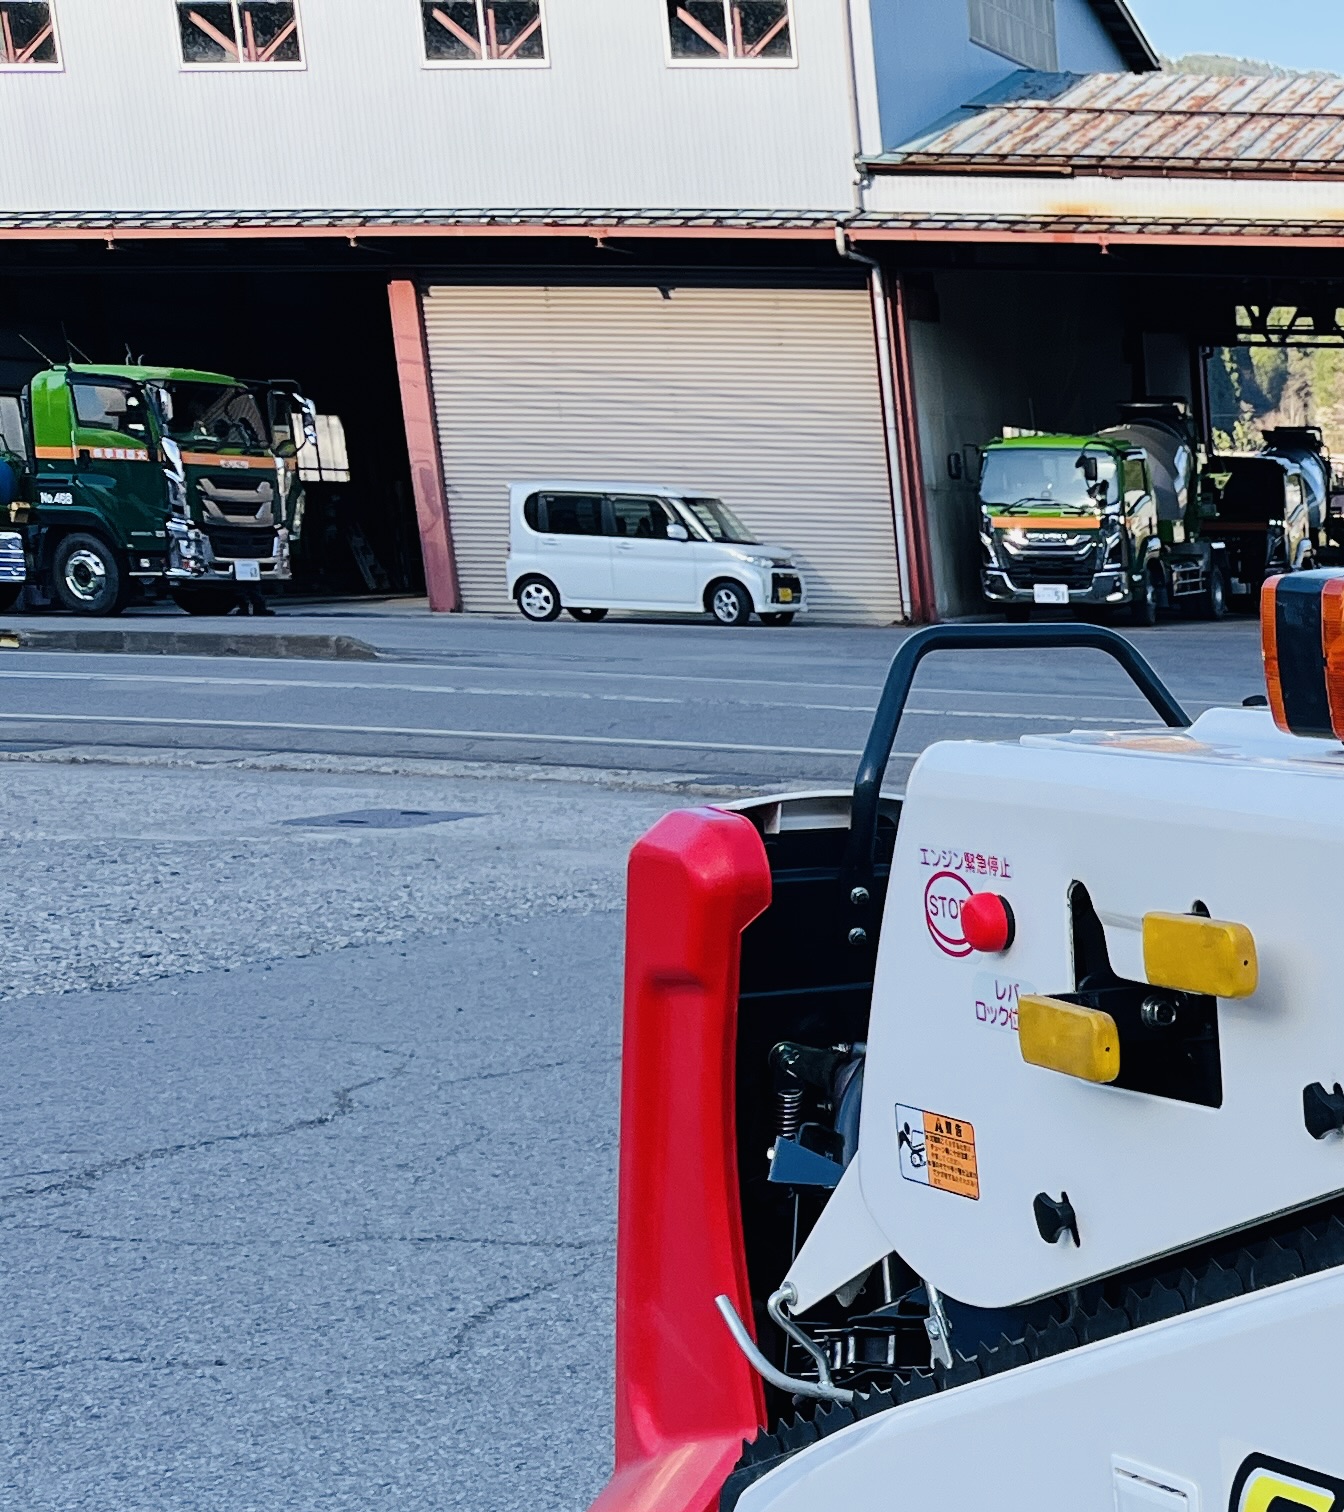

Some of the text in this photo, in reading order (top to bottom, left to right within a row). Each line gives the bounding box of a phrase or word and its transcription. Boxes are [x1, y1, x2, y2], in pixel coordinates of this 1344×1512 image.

[919, 848, 1012, 879] エンジン緊急停止
